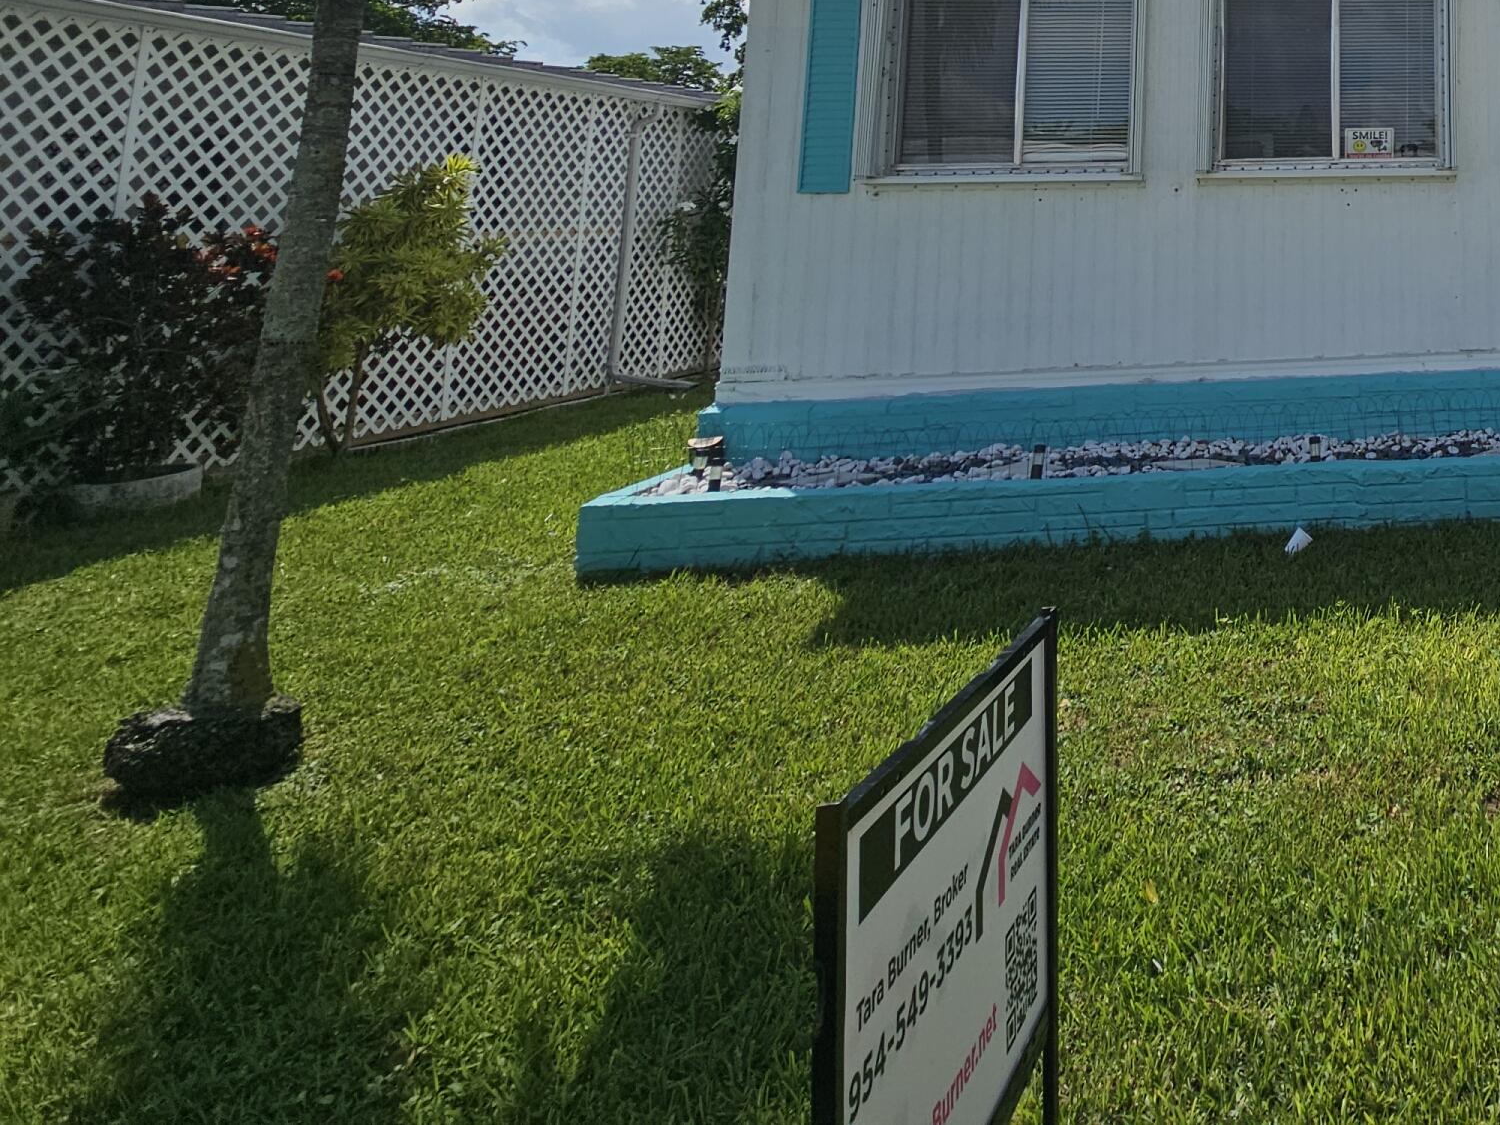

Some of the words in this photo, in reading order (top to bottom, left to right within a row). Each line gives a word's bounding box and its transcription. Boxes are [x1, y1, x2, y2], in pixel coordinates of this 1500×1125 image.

[1352, 131, 1388, 140] SMILE!
[894, 750, 954, 871] FOR
[960, 680, 1016, 790] SALE
[848, 904, 973, 1125] 954-549-3393
[856, 978, 885, 1033] Tara
[887, 915, 931, 992] Burner,
[933, 862, 969, 926] Broker
